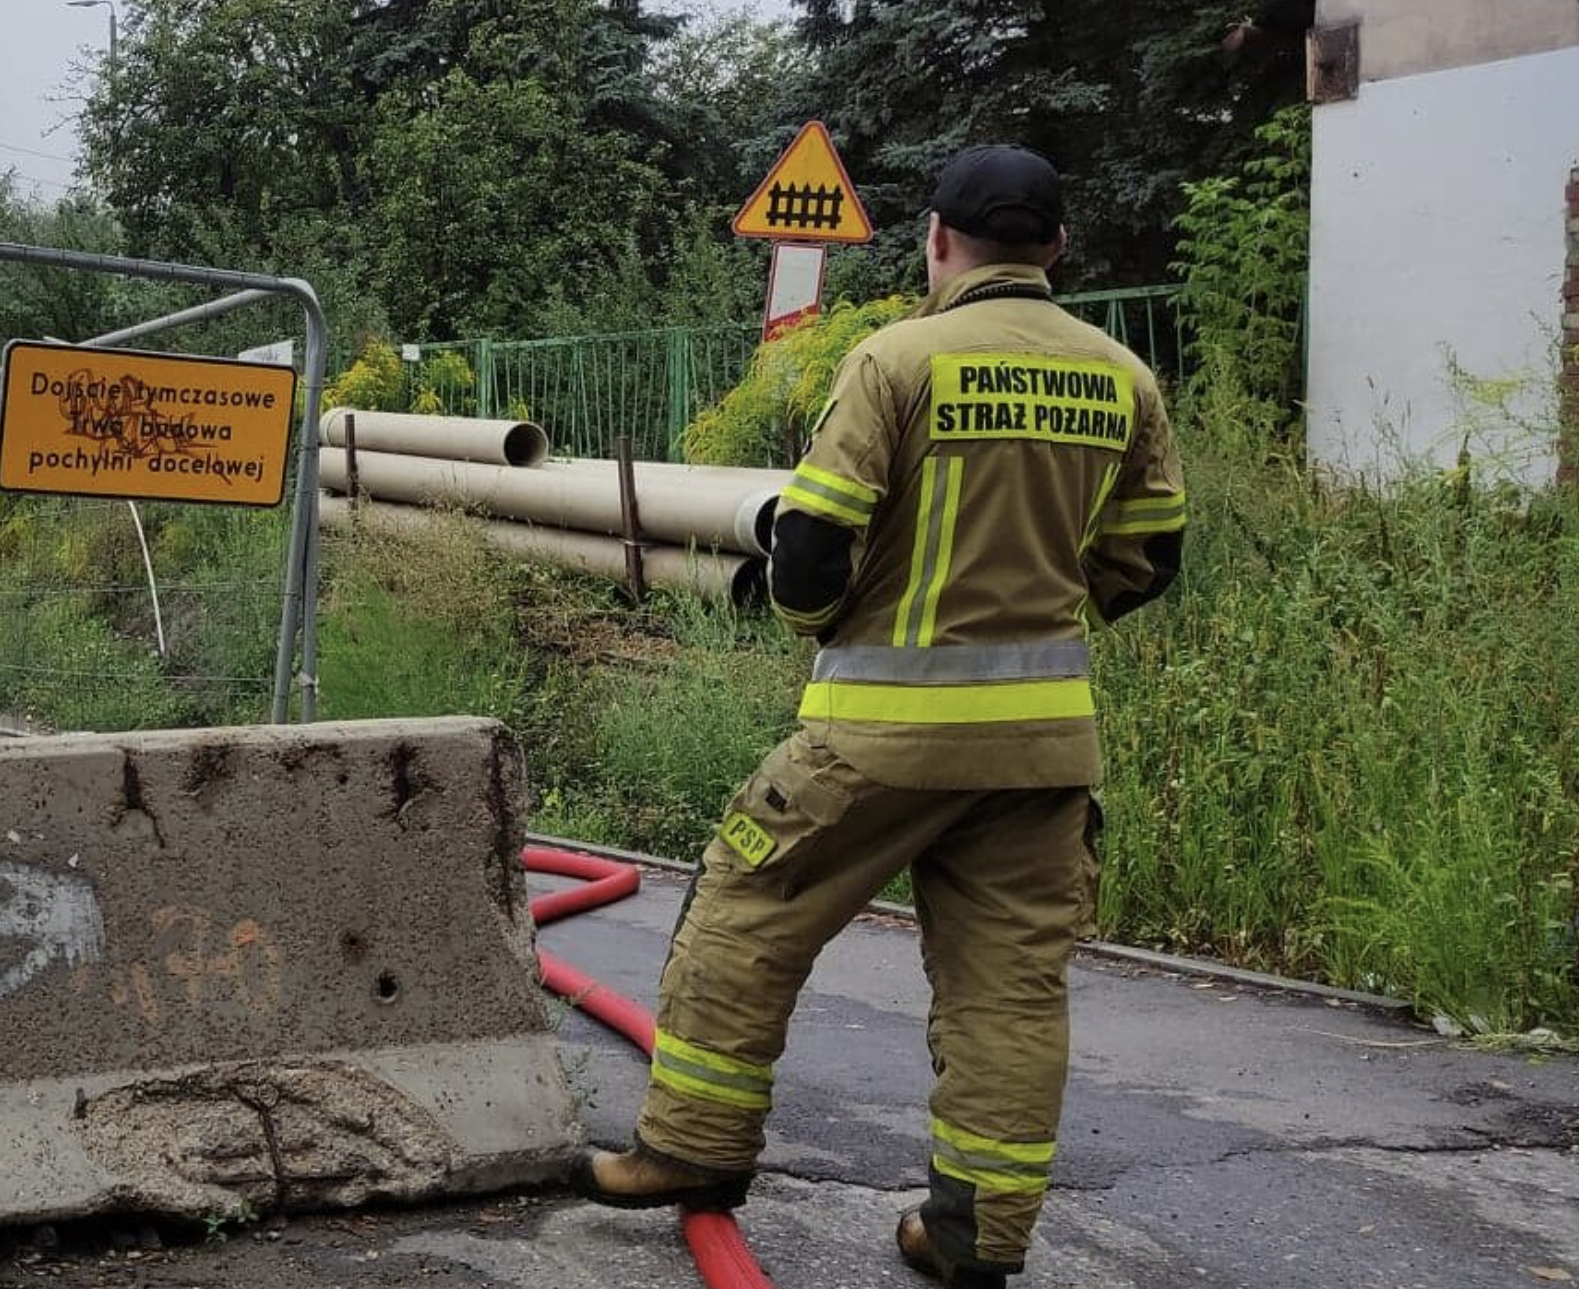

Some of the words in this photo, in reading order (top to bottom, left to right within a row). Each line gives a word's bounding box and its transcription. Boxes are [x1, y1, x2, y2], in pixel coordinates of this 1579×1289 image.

[135, 380, 276, 409] tymczasowe
[959, 360, 1118, 403] PAŃSTWOWA
[29, 446, 132, 477] pochylni
[148, 451, 264, 483] docelowej
[729, 819, 765, 855] PSP
